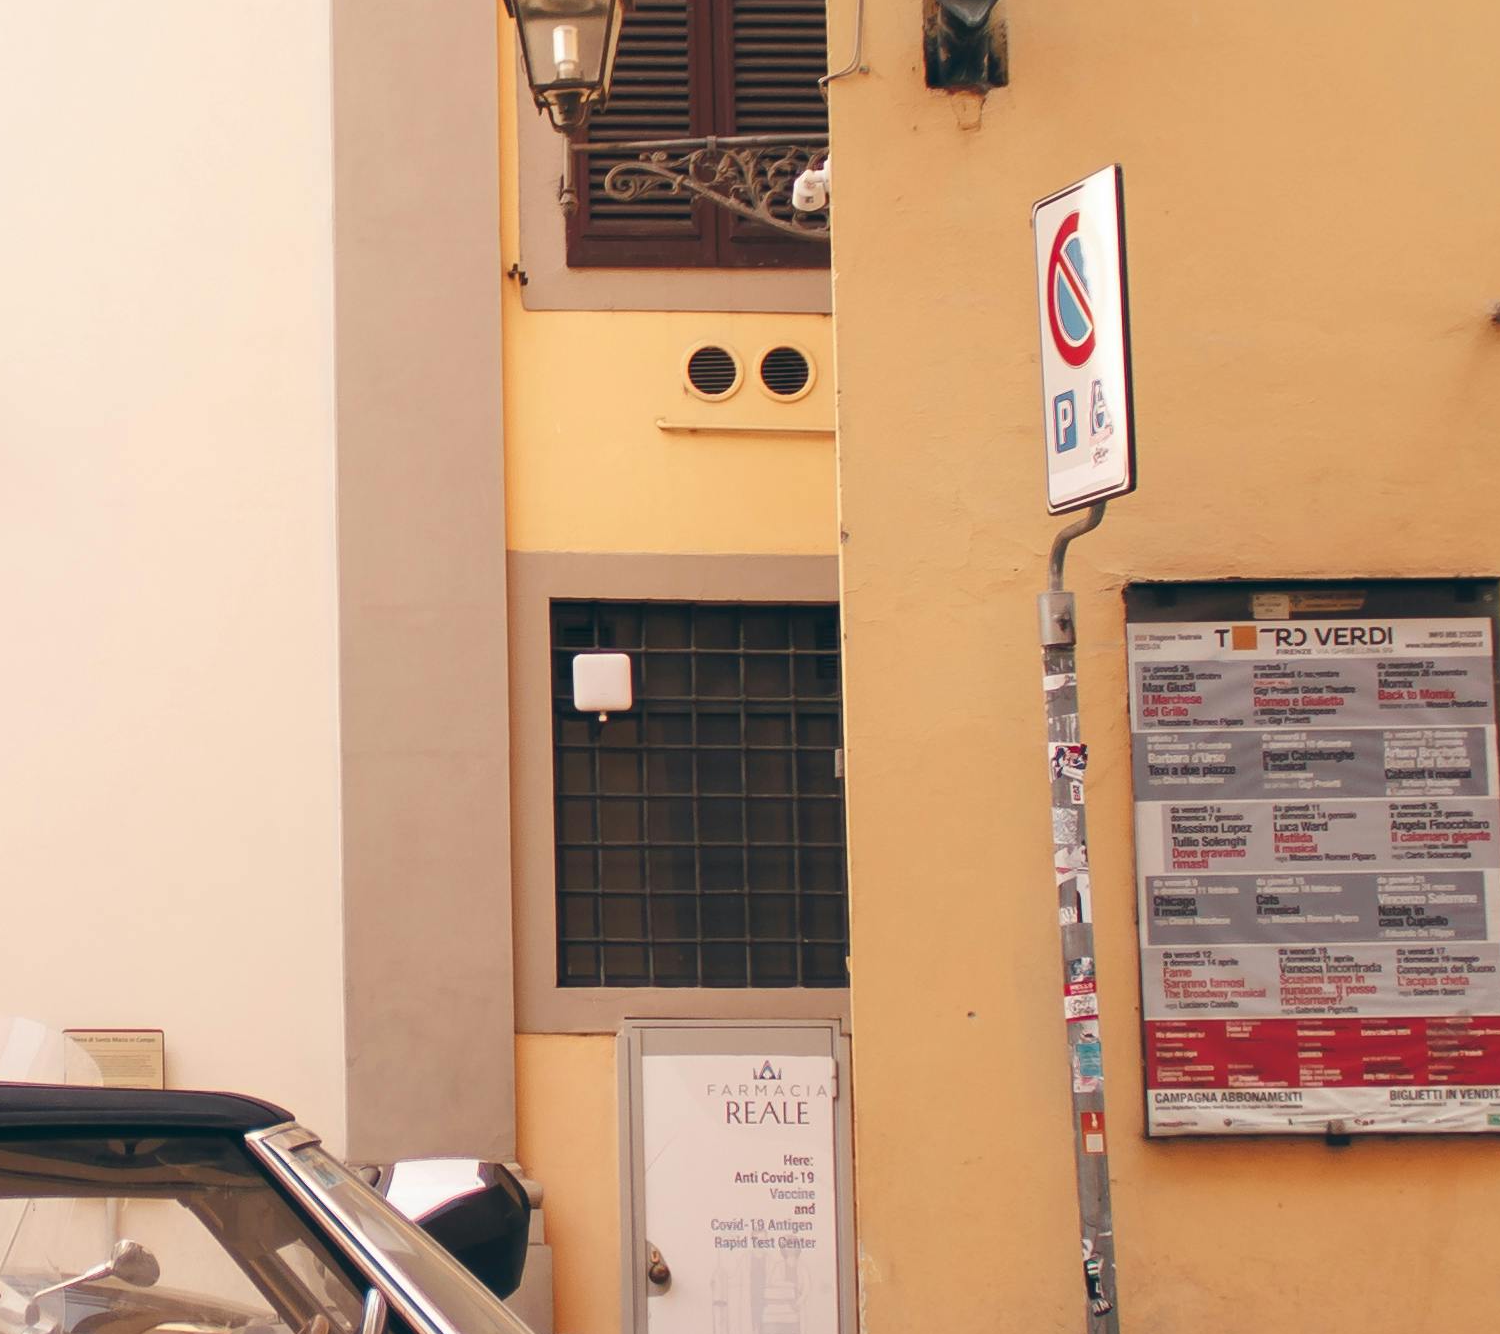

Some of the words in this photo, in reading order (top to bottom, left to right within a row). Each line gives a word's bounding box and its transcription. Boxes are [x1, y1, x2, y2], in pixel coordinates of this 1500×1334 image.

[1058, 399, 1073, 445] P
[1314, 627, 1393, 646] VERDI
[1142, 683, 1164, 692] Max
[1167, 682, 1196, 692] Giusti
[1379, 679, 1412, 688] Momix
[1152, 695, 1202, 705] Marchese
[1378, 690, 1403, 700] Back
[1406, 691, 1417, 699] to
[1420, 689, 1455, 699] Momix
[1254, 697, 1290, 707] Romeo
[1302, 696, 1344, 707] Giulietta
[1143, 707, 1158, 717] del
[1162, 706, 1188, 716] Grillo
[1203, 765, 1236, 777] piazze
[1172, 824, 1218, 833] Massimo
[1222, 824, 1252, 835] Lopez
[1274, 822, 1298, 832] Luca
[1301, 822, 1328, 831] Ward
[1391, 820, 1427, 832] Angela
[1430, 819, 1489, 830] Finocchiaro
[1172, 837, 1199, 847] Tullio
[1202, 836, 1247, 848] Solenghi
[1275, 833, 1312, 843] Matilda
[1401, 832, 1449, 842] calamaro
[1452, 831, 1491, 843] gigante
[1173, 849, 1198, 858] Dove
[1201, 849, 1245, 858] eravamo
[1282, 844, 1318, 853] musical
[1173, 860, 1208, 869] rimasti
[1154, 896, 1196, 908] Chicago
[1256, 895, 1279, 905] Cats
[1378, 906, 1412, 917] Natale
[1415, 906, 1424, 915] in
[1379, 918, 1403, 927] casa
[1163, 968, 1192, 977] Fame
[1280, 964, 1323, 974] Vanessa
[1326, 963, 1382, 973] Incontrada
[1397, 965, 1448, 976] Compagnia
[1451, 964, 1464, 973] del
[1164, 979, 1207, 989] Saranno
[1210, 979, 1245, 988] famosi
[1280, 975, 1325, 985] Scusami
[1328, 975, 1352, 984] sono
[1355, 975, 1365, 984] in
[1398, 976, 1437, 988] L'acqua
[1440, 975, 1470, 985] cheta
[1165, 990, 1181, 999] The
[1183, 989, 1229, 1001] Broadway
[1231, 989, 1266, 997] musical
[1346, 986, 1377, 995] posso
[1281, 996, 1343, 1005] richiamare?
[707, 1084, 828, 1097] FARMACIA
[1390, 1089, 1442, 1100] BIGLIETTI
[1446, 1089, 1457, 1099] IN
[1155, 1092, 1217, 1103] CAMPAGNA
[1221, 1091, 1303, 1102] ABBONAMENTI
[726, 1101, 810, 1125] REALE
[783, 1154, 814, 1166] Here:
[734, 1172, 758, 1183] Anti
[761, 1171, 815, 1183] Covid-19
[770, 1188, 816, 1199] Vaccine
[794, 1203, 816, 1215] and
[711, 1219, 765, 1231] Covid-19
[768, 1219, 813, 1233] Antigen
[714, 1237, 748, 1250] Rapid
[752, 1237, 775, 1249] Test
[778, 1236, 816, 1249] Center
